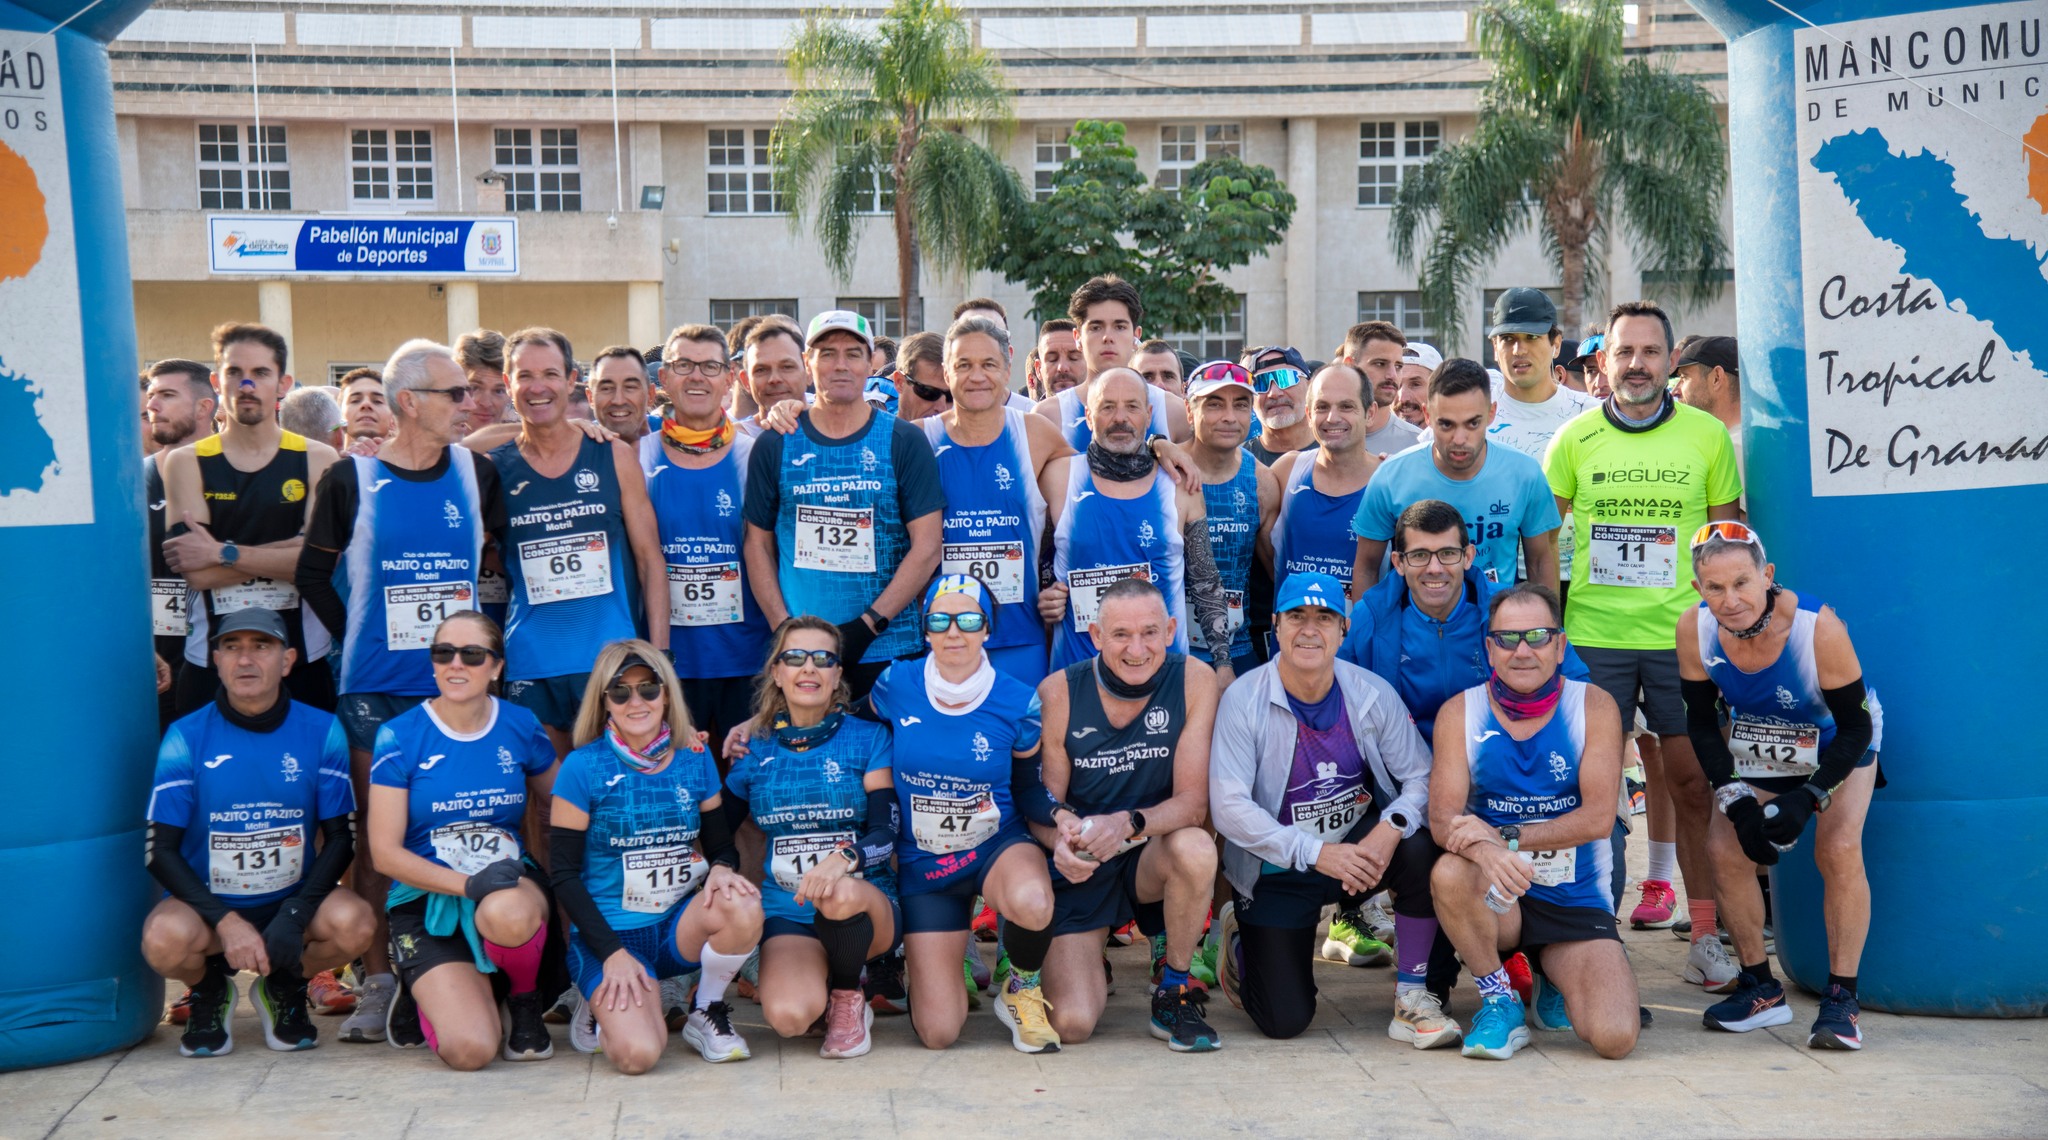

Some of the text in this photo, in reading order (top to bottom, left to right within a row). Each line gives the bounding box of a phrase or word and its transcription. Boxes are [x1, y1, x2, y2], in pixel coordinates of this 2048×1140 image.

[1806, 19, 2040, 82] MANCOMU
[1808, 77, 2040, 121] DE MUNIC
[310, 226, 458, 244] Pabellón Municipal
[249, 241, 288, 251] deportes
[337, 246, 427, 266] de Deportes
[1819, 275, 1937, 320] Costa
[1819, 340, 1995, 407] Tropical
[1579, 430, 1598, 443] luanvi
[1825, 428, 1870, 474] De
[579, 474, 594, 485] 30
[793, 483, 830, 495] PAZITO
[842, 481, 881, 491] PAZITO
[824, 494, 849, 503] Motril
[1595, 499, 1683, 509] GRANADA
[511, 512, 552, 527] PAZITO
[563, 504, 606, 518] PAZITO
[801, 515, 843, 524] CONJURO
[1597, 509, 1681, 518] RUNNERS
[546, 521, 573, 531] Motril
[944, 516, 1019, 528] AZITO a PAZITO
[1217, 524, 1249, 532] PAZITO
[815, 526, 858, 546] 132
[969, 529, 991, 537] Motril
[524, 546, 571, 558] CONJURO
[694, 545, 701, 553] a
[705, 544, 736, 554] PAZITO
[1617, 543, 1645, 561] 11
[946, 552, 992, 560] CONJURO
[382, 561, 419, 570] PAZITO
[435, 560, 468, 569] PAZITO
[550, 554, 582, 575] 66
[969, 561, 999, 579] 60
[1286, 560, 1316, 572] PAZITO
[1073, 576, 1117, 586] CONJURO
[391, 593, 440, 602] CONJURO
[684, 583, 715, 601] 65
[417, 601, 447, 622] 61
[1149, 711, 1164, 725] 30
[1735, 732, 1780, 743] CONJURO
[1075, 756, 1116, 769] PAZITO
[1126, 747, 1169, 761] PAZITO
[1749, 744, 1797, 764] 112
[1109, 762, 1135, 775] Motril
[901, 772, 991, 791] PAZITO a PAZITO
[432, 799, 473, 812] PAZITO
[489, 794, 523, 806] PAZITO
[915, 805, 963, 814] CONJURO
[1488, 796, 1576, 813] PAZITO a PAZITO
[210, 811, 249, 822] PAZITO
[265, 809, 304, 819] PAZITO
[469, 809, 493, 818] Motril
[757, 812, 795, 825] PAZITO
[808, 808, 854, 820] PAZITO
[1298, 804, 1344, 820] CONJURO
[1520, 812, 1544, 820] Motril
[245, 822, 269, 831] Motril
[792, 822, 819, 830] Motril
[940, 815, 972, 832] 47
[1315, 808, 1354, 834] 180
[214, 841, 267, 849] CONJURO
[455, 834, 500, 855] 104
[610, 835, 654, 847] PAZITO
[777, 844, 820, 854] CONJURO
[232, 848, 280, 871] 131
[628, 857, 677, 869] CONJURO
[925, 851, 977, 880] HANKER
[646, 864, 691, 888] 115
